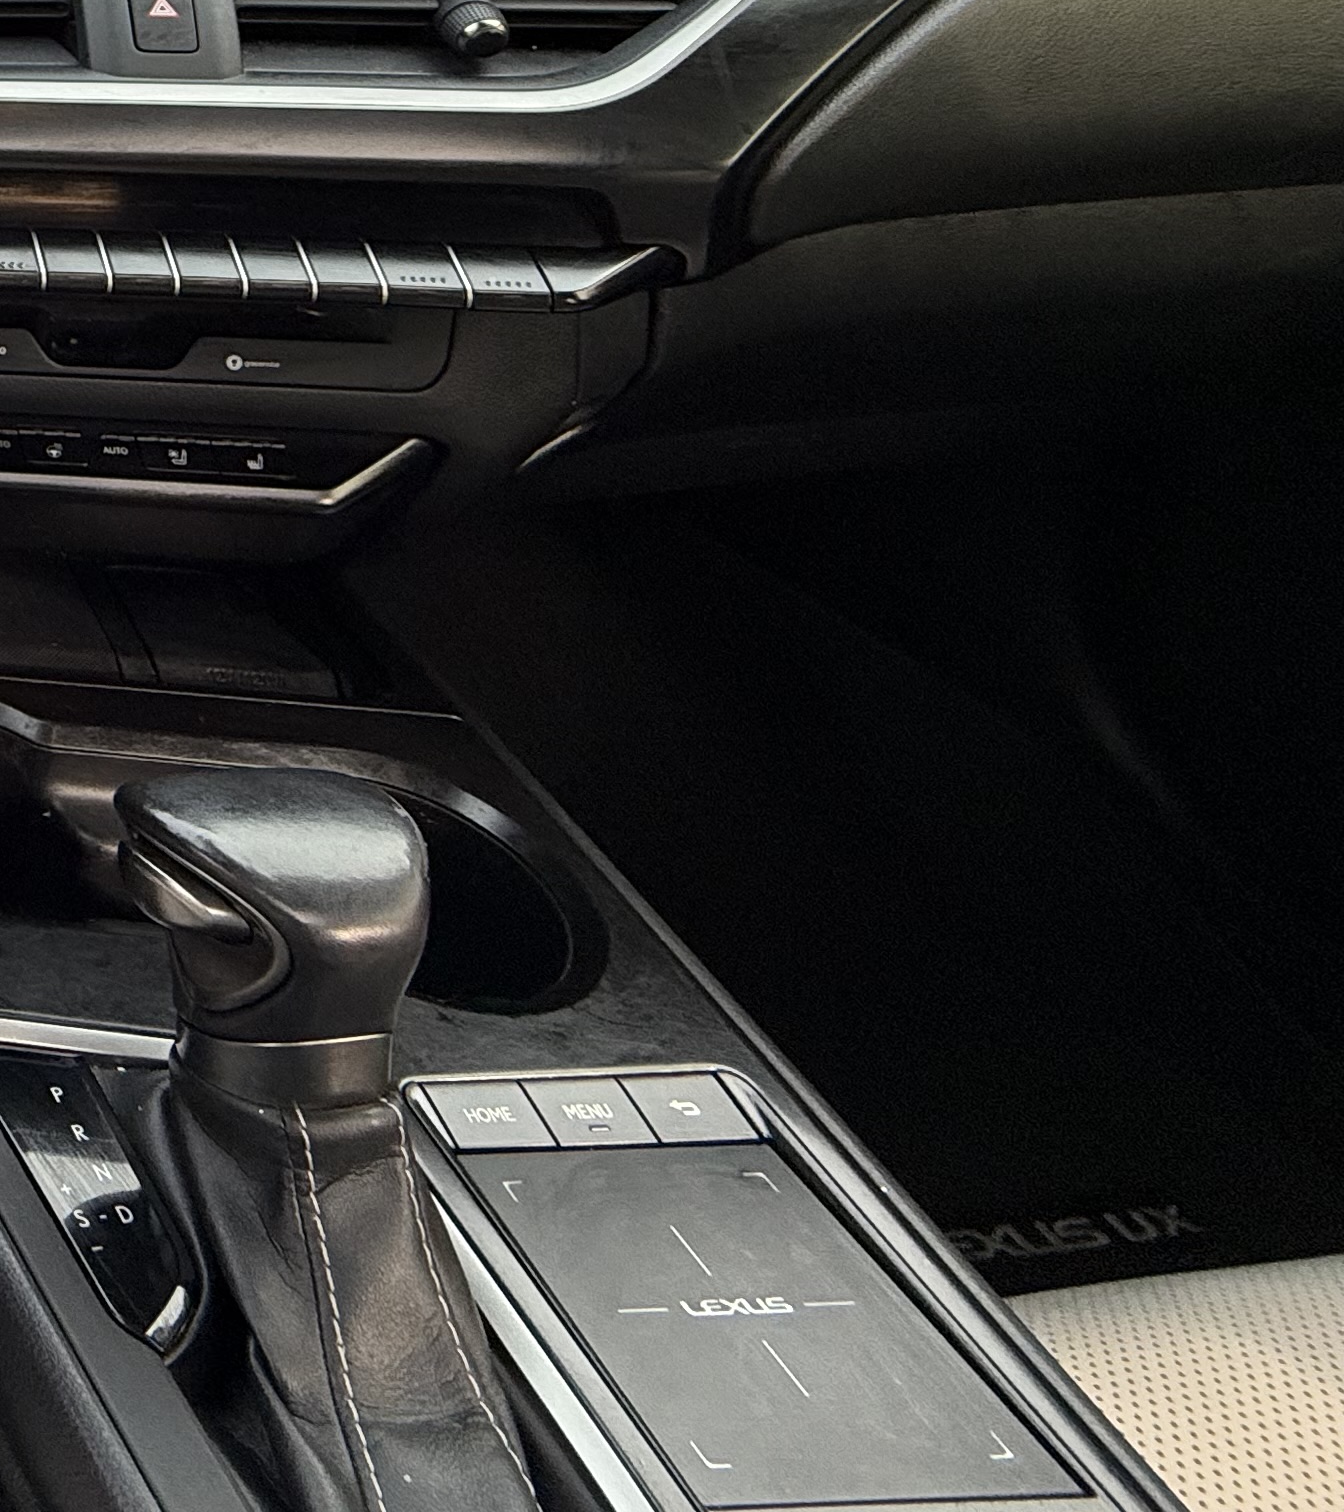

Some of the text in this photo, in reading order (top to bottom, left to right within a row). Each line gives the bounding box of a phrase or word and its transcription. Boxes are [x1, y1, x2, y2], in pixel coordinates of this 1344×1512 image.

[102, 445, 129, 456] AUTO
[49, 1086, 64, 1104] P
[462, 1103, 517, 1127] HOME
[561, 1099, 614, 1122] MENU
[71, 1123, 89, 1141] R
[93, 1163, 112, 1182] N
[73, 1205, 134, 1228] S D
[1102, 1204, 1204, 1243] UX
[679, 1296, 794, 1317] LEXUS
